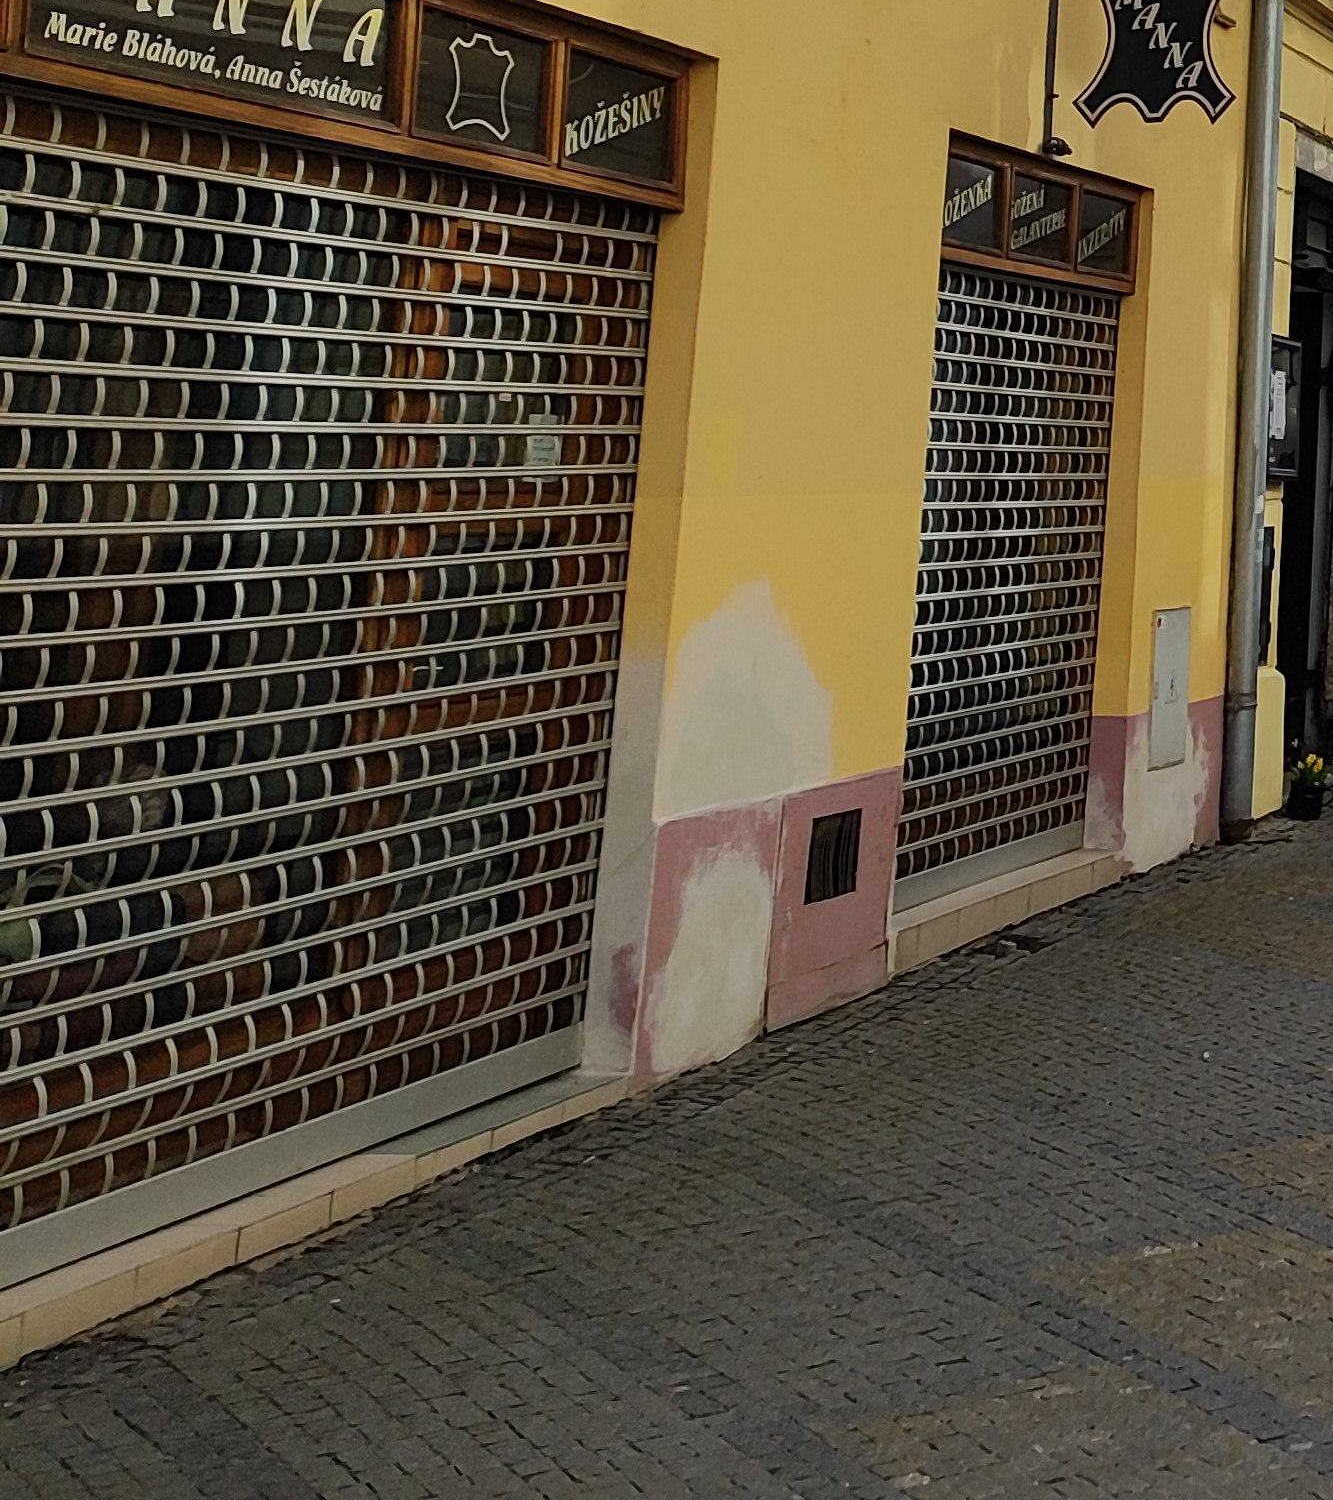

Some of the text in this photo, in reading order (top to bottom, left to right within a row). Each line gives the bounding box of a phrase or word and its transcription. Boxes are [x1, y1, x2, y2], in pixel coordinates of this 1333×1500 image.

[44, 11, 383, 112] Marie Bláhová, Anna Šestáková
[564, 86, 665, 158] KOŽEŠINY
